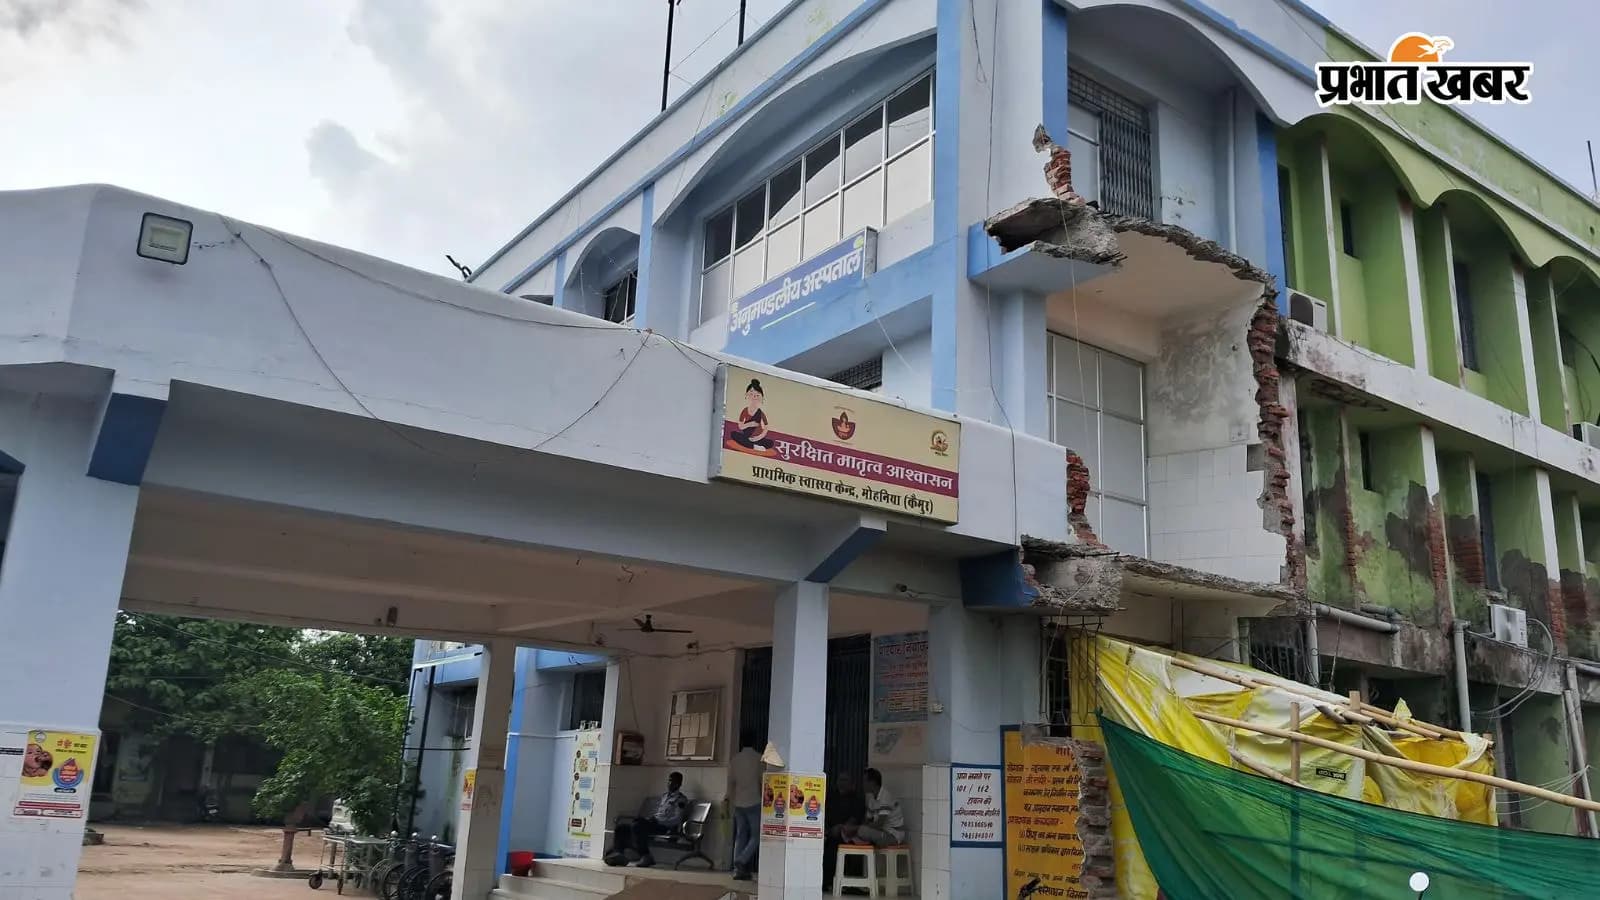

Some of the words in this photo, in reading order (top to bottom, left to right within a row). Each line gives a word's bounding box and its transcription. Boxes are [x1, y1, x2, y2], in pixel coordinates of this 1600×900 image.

[752, 465, 797, 484] प्राथमिक
[798, 475, 833, 492] स्वास्थ्य
[834, 479, 859, 499] केन्द्र,
[861, 485, 902, 506] मोहनिया
[774, 438, 833, 464] सुरक्षित
[836, 452, 883, 477] मातृत्व
[886, 463, 953, 490] आश्वासन
